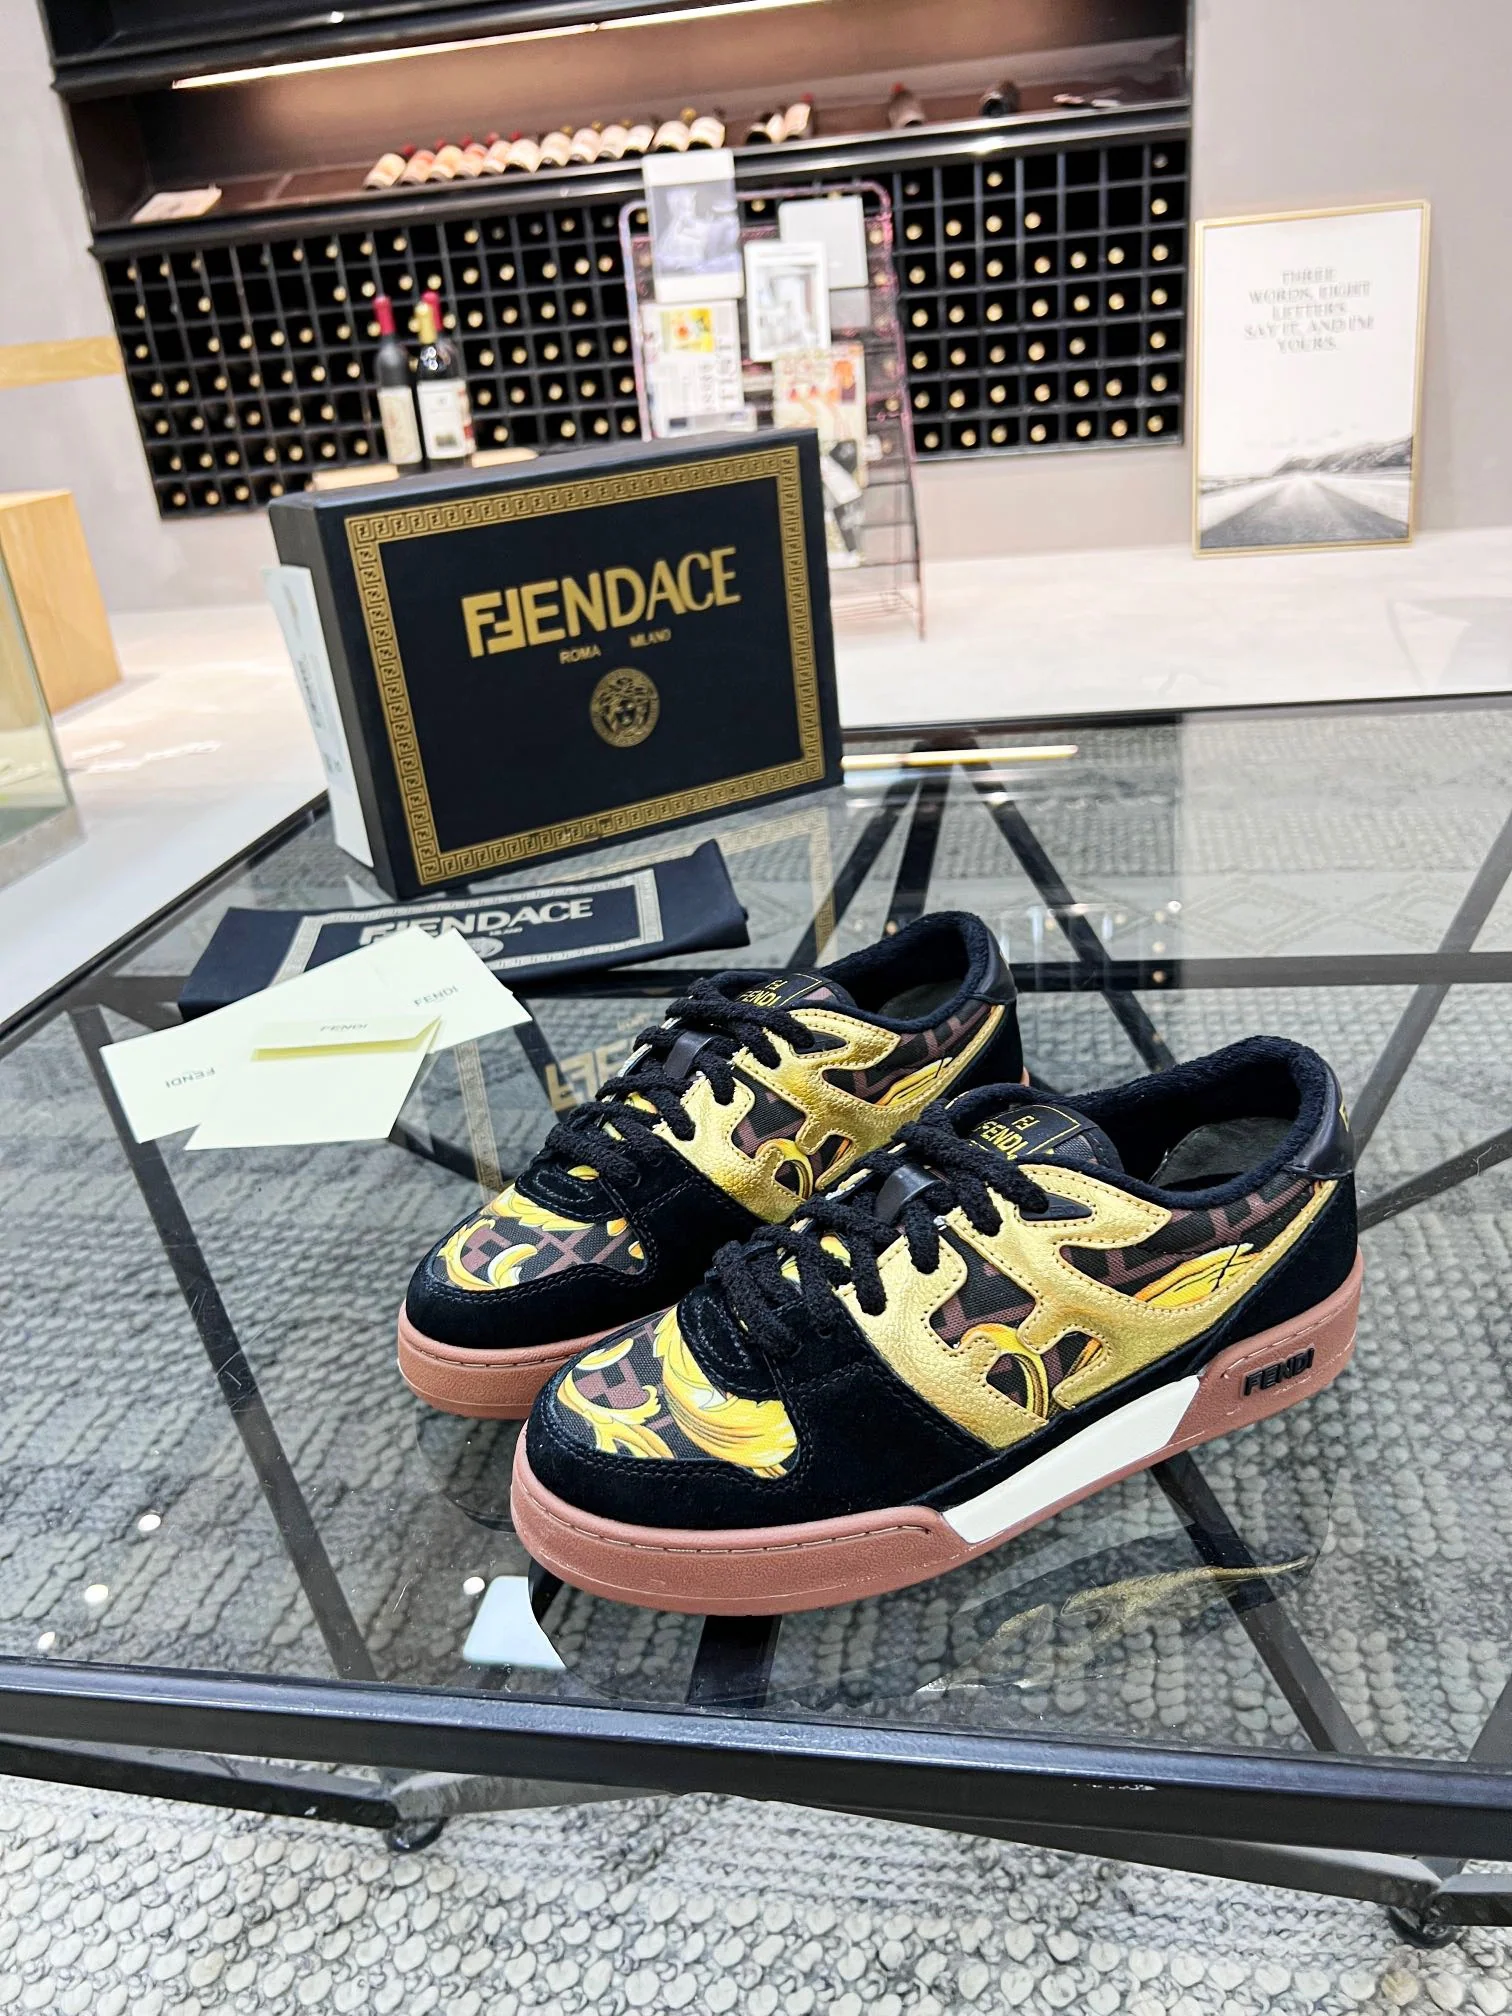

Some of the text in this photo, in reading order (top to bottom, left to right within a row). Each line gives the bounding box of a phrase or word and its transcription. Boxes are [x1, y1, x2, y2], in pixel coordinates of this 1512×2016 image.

[559, 628, 672, 664] ROMA MILANO
[413, 985, 459, 1008] FENDI
[738, 989, 782, 1007] FENDI
[320, 1022, 368, 1032] FENDI
[165, 1066, 216, 1089] FENDI
[980, 1120, 1029, 1159] FENDI
[1244, 1347, 1315, 1396] FENDI
